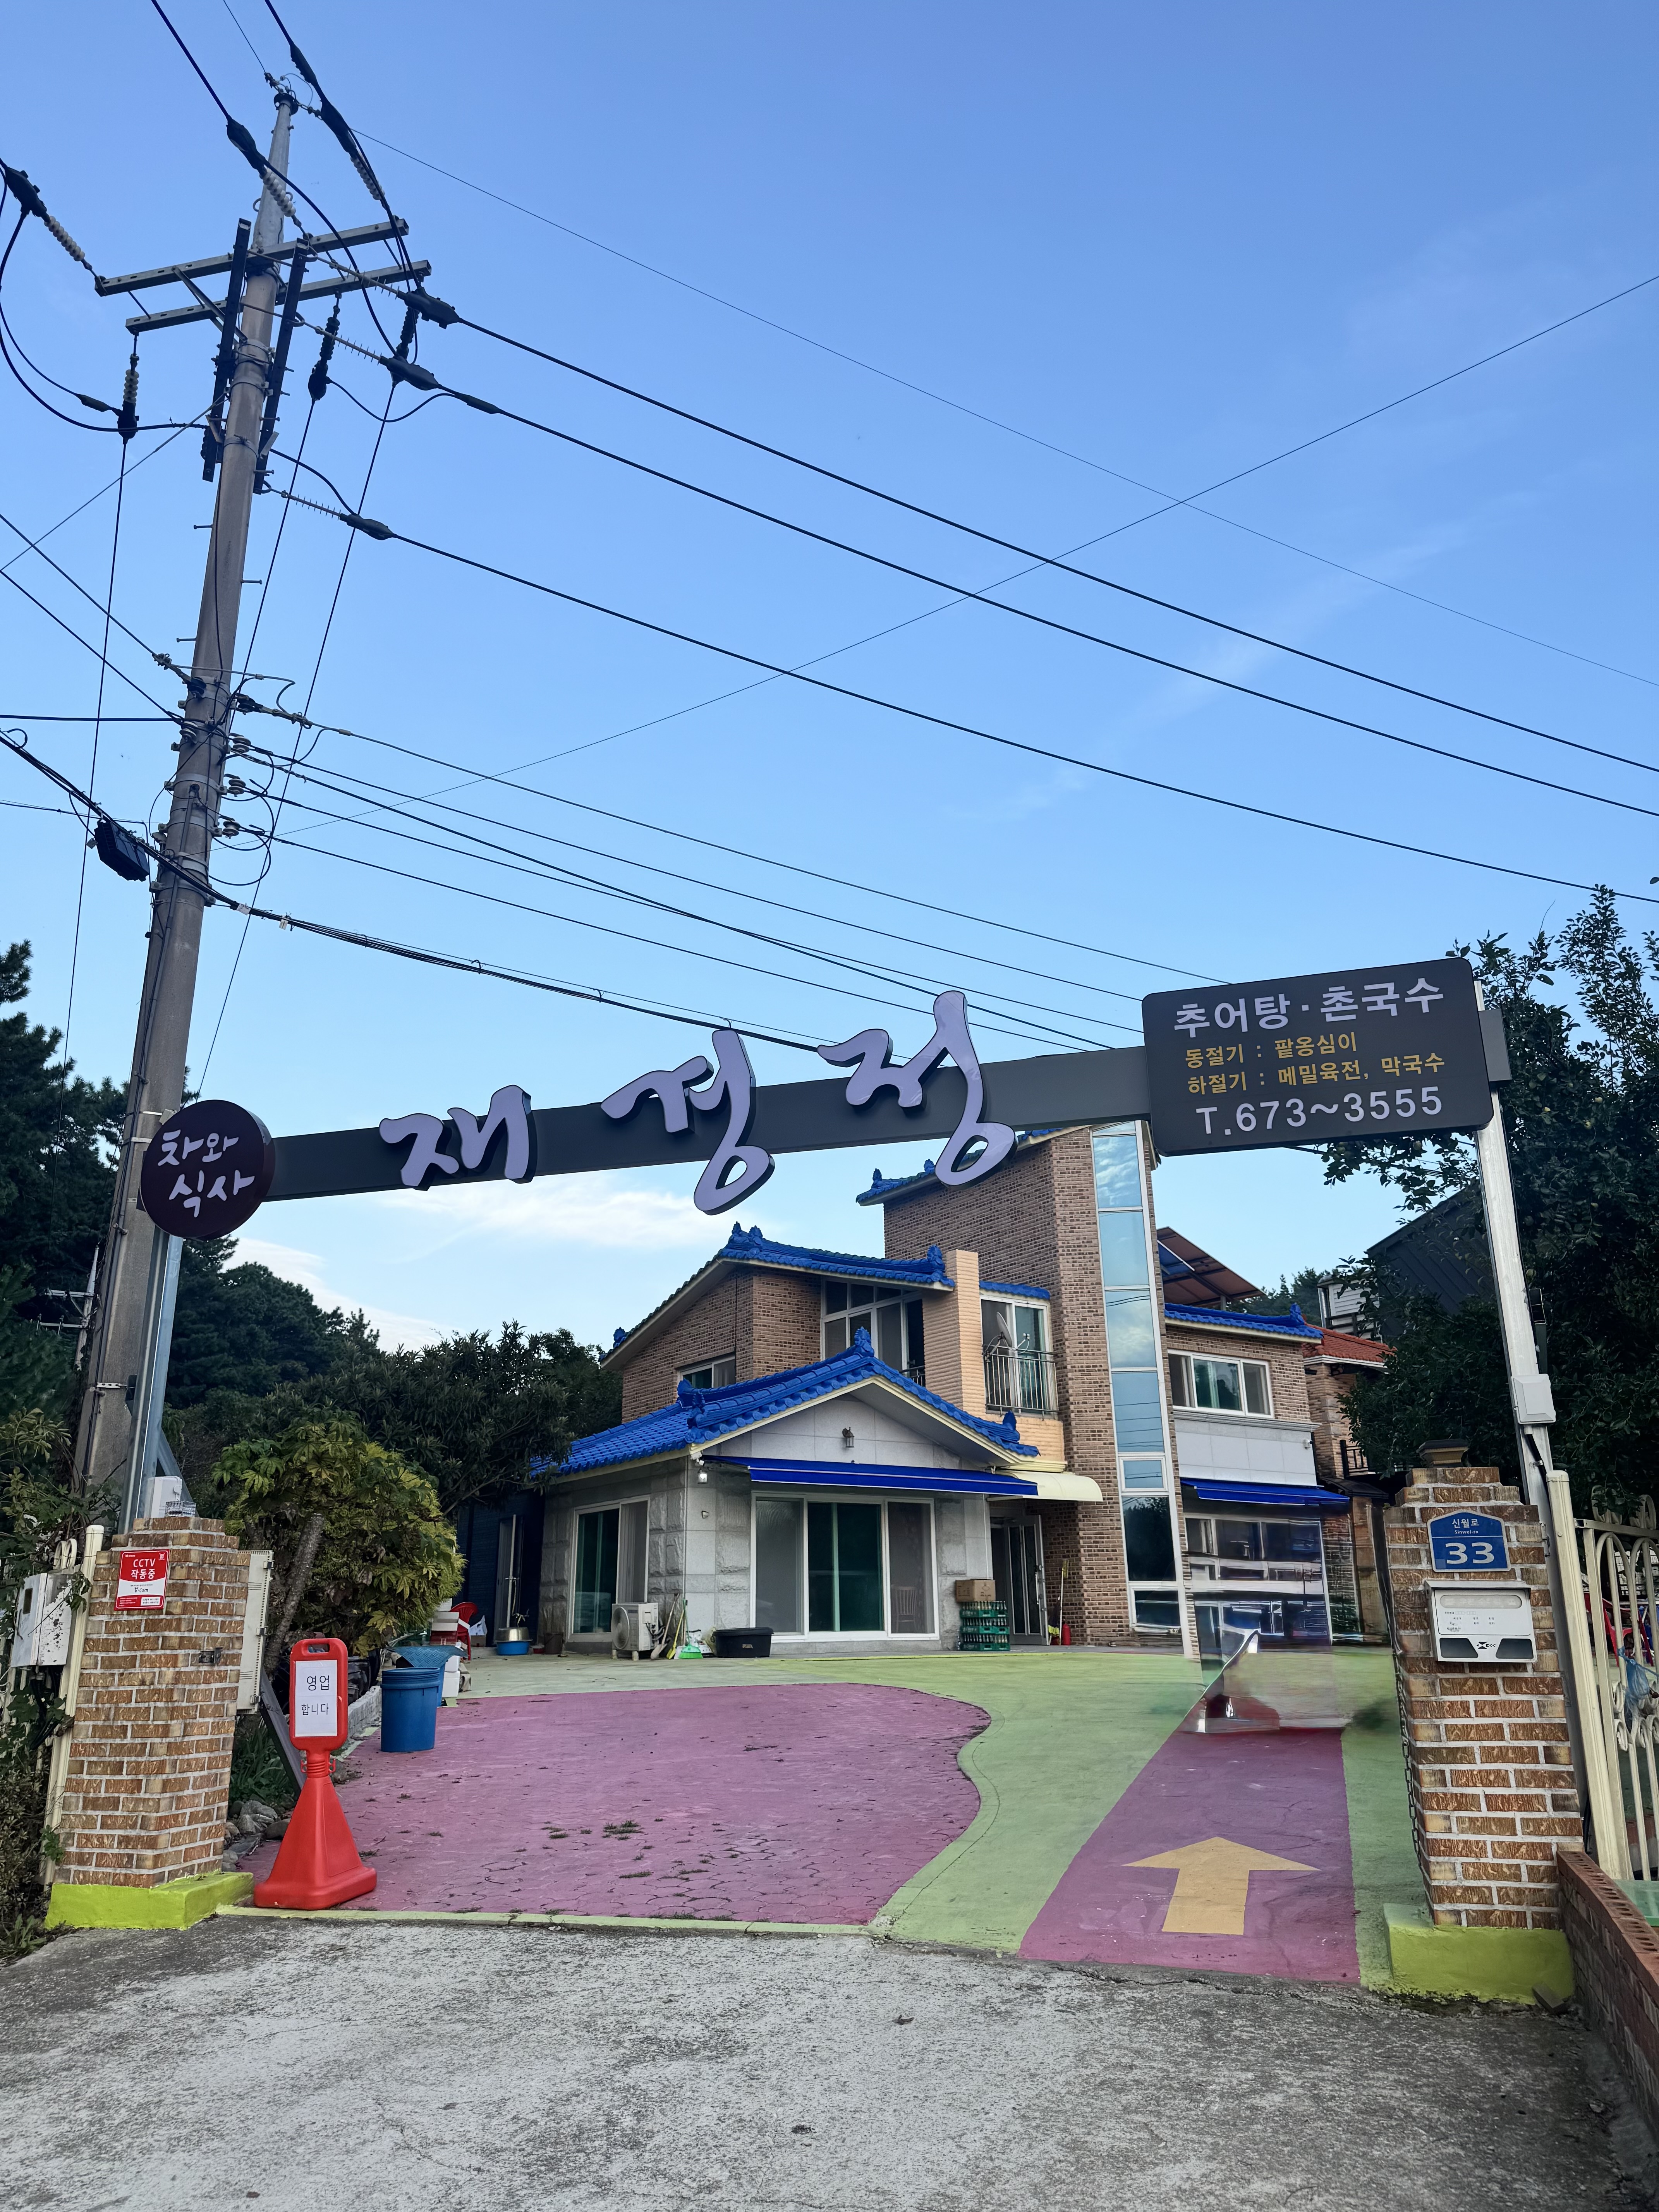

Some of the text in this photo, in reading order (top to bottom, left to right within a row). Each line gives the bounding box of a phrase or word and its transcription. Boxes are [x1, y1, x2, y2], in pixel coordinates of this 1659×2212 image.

[1185, 1043, 1244, 1068] 동절기
[1274, 1032, 1357, 1059] 팥옹심이
[1187, 1071, 1247, 1095] 하절기
[1278, 1060, 1369, 1086] 메밀육전,
[1381, 1052, 1445, 1078] 막국수
[1196, 1085, 1442, 1136] T.673~3555
[157, 1129, 239, 1166] 차와
[169, 1170, 254, 1218] 식사
[1452, 1518, 1480, 1528] 신월로
[133, 1558, 156, 1567] CCTV
[1445, 1542, 1494, 1564] 33
[131, 1568, 155, 1580] 작동중
[307, 1675, 330, 1691] 영업
[301, 1703, 329, 1716] 합니다
